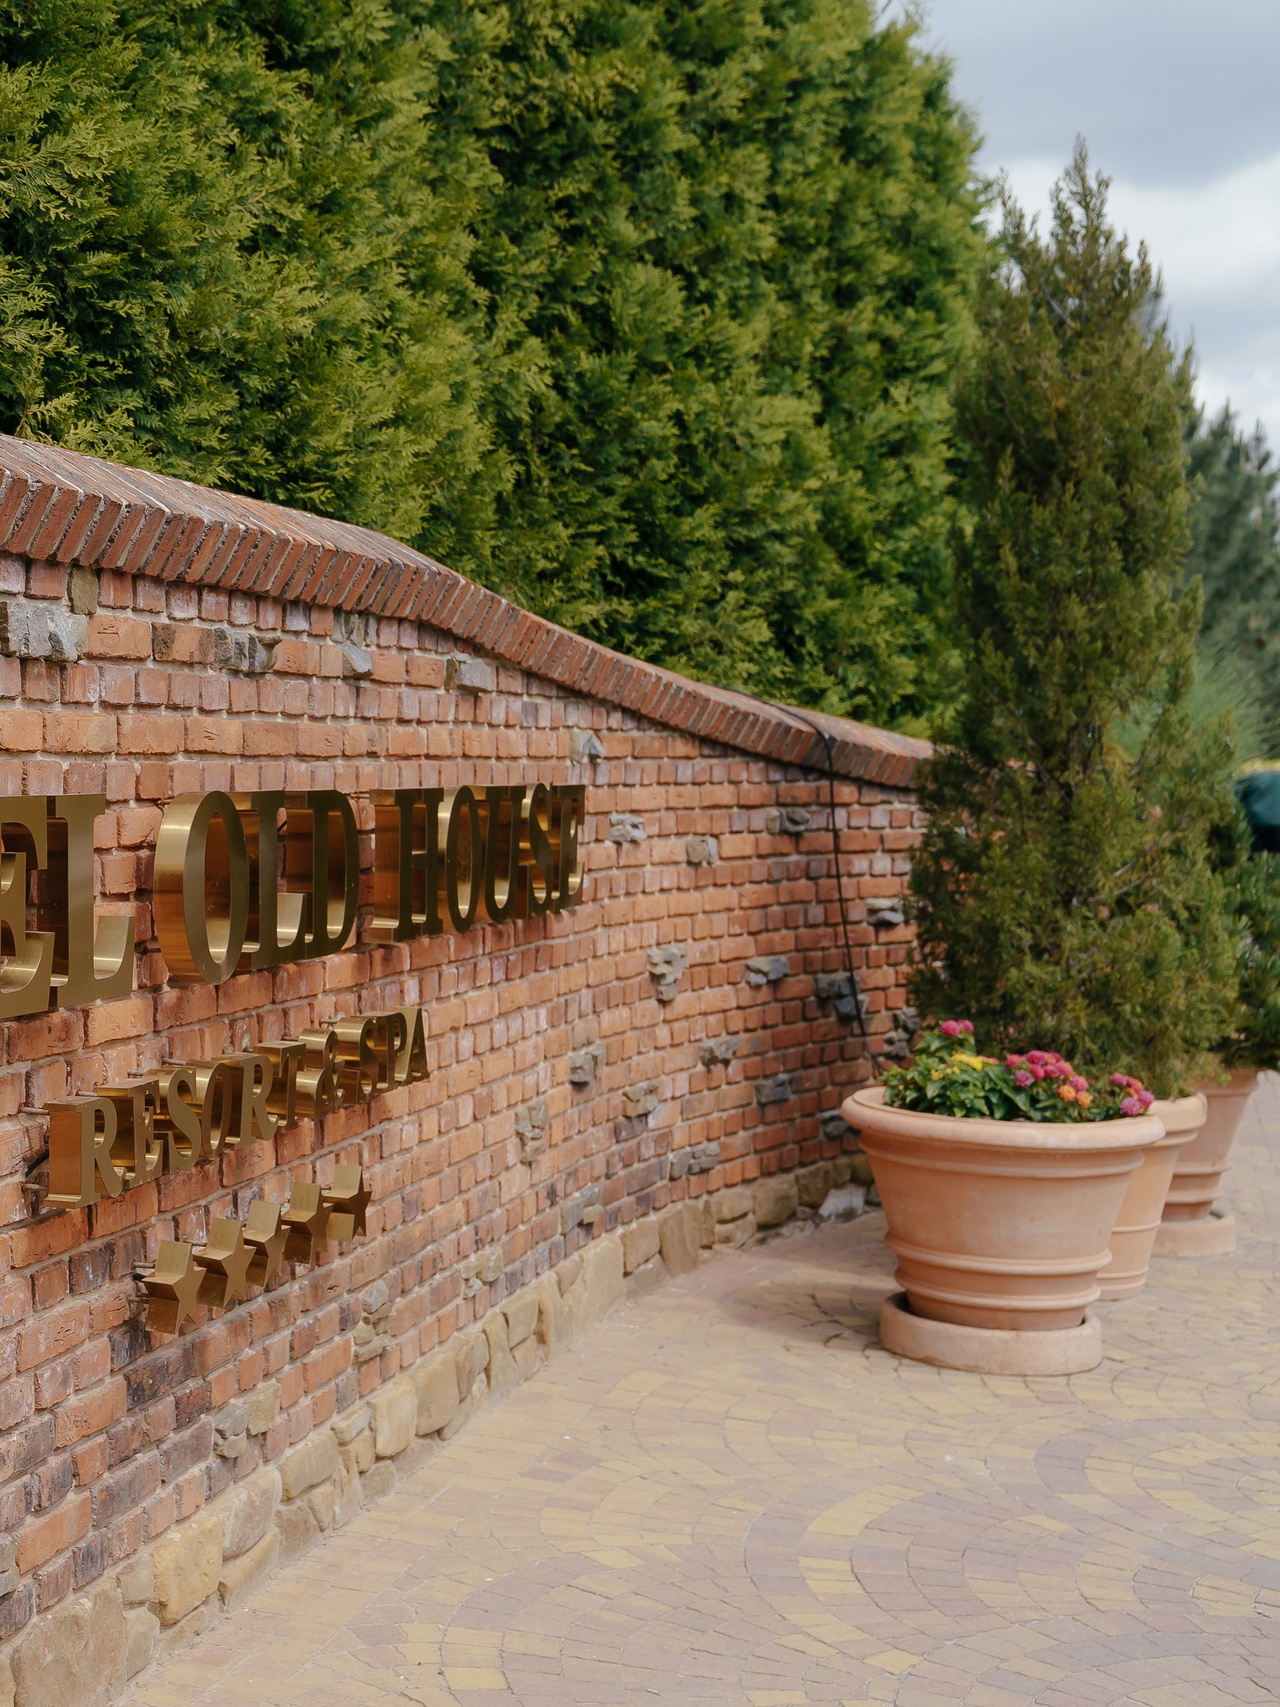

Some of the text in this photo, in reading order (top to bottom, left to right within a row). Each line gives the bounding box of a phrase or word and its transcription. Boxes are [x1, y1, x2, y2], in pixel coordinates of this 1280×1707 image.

[154, 789, 360, 984] OLD
[369, 782, 586, 942] HOUSE
[47, 1040, 307, 1209] RESORT
[338, 1006, 431, 1103] SPA
